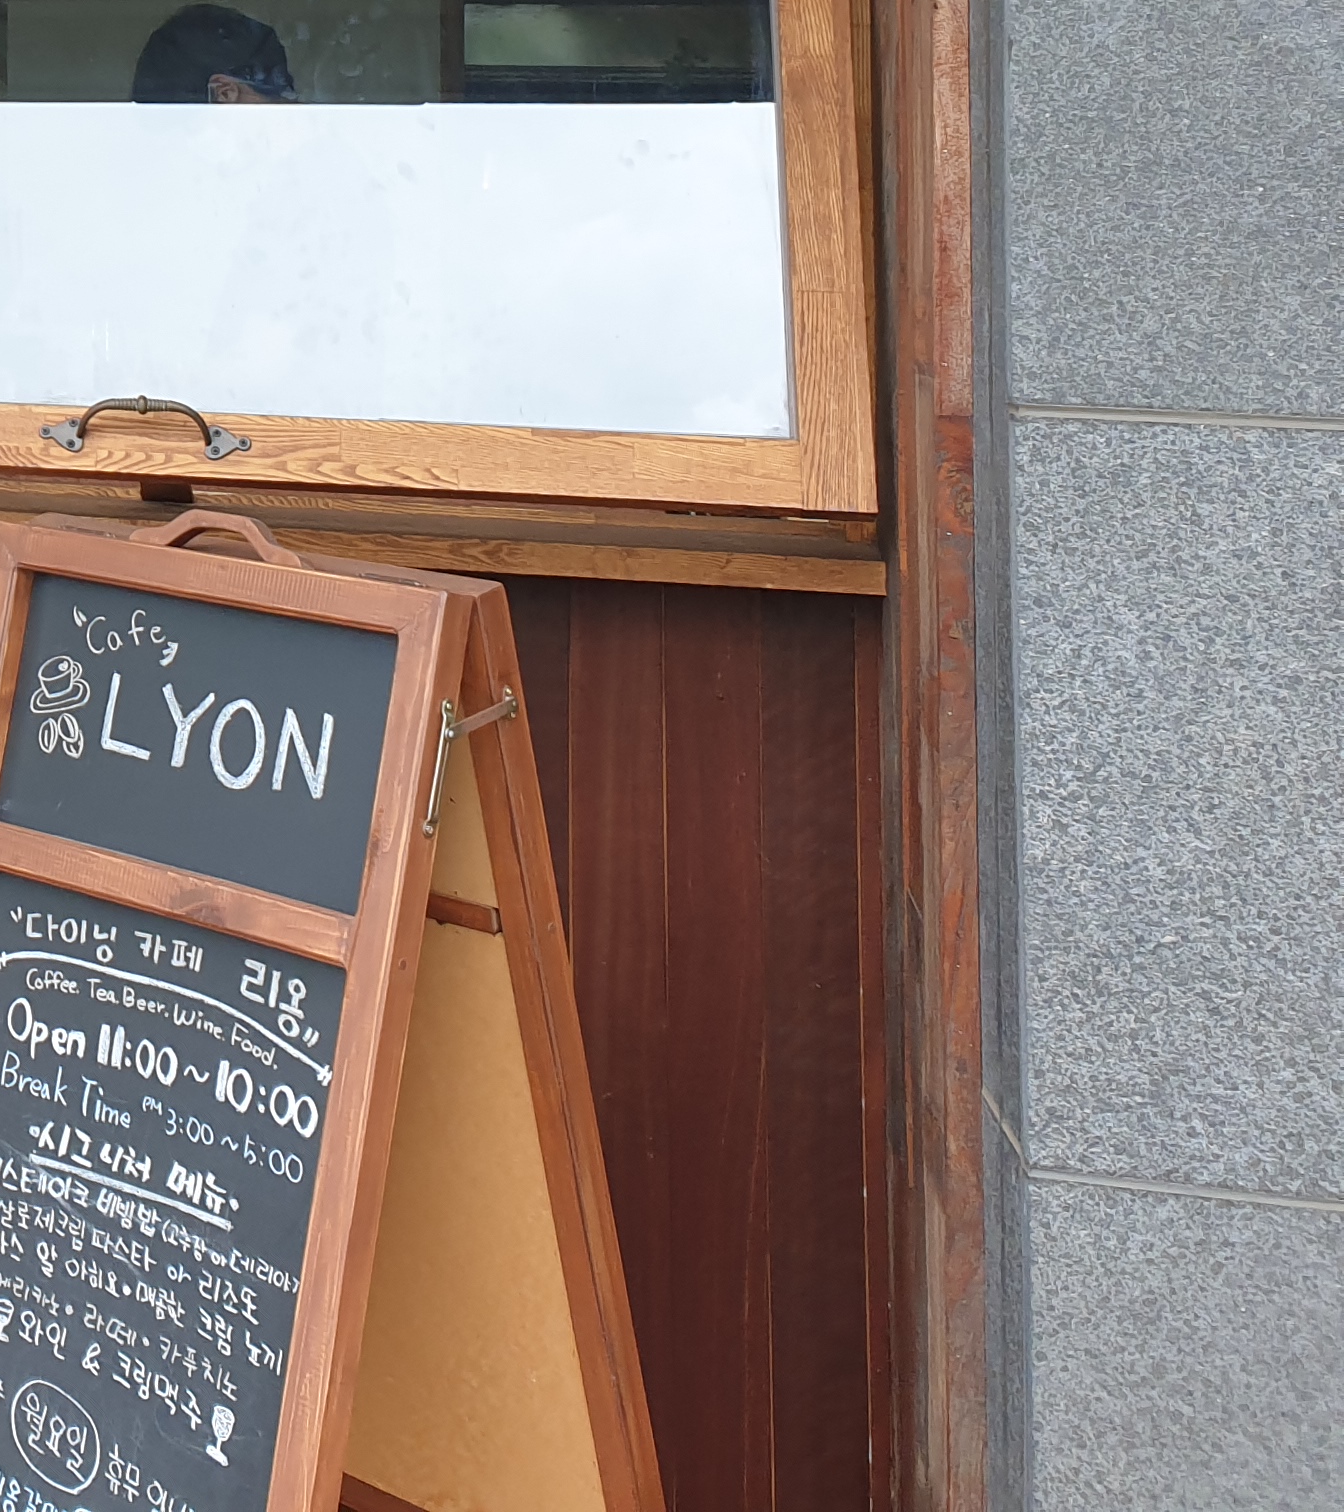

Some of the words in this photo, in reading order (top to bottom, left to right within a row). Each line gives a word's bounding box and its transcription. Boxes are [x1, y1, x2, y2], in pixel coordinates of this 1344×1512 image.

[101, 671, 334, 799] LYON
[135, 930, 203, 972] 카페
[7, 998, 86, 1059] Open
[1, 1050, 68, 1106] Break
[81, 1075, 131, 1129] Time
[96, 1188, 161, 1238] 비빔밥
[166, 1160, 227, 1214] 메뉴
[36, 1241, 58, 1278] 알
[197, 1306, 232, 1356] 크림
[198, 1268, 259, 1326] 리조또
[18, 1310, 67, 1360] 와인
[81, 1342, 101, 1376] &
[83, 1301, 137, 1347] 라떼
[159, 1335, 238, 1402] 카푸치노
[20, 1392, 88, 1482] 월요일
[104, 1444, 141, 1503] 휴무
